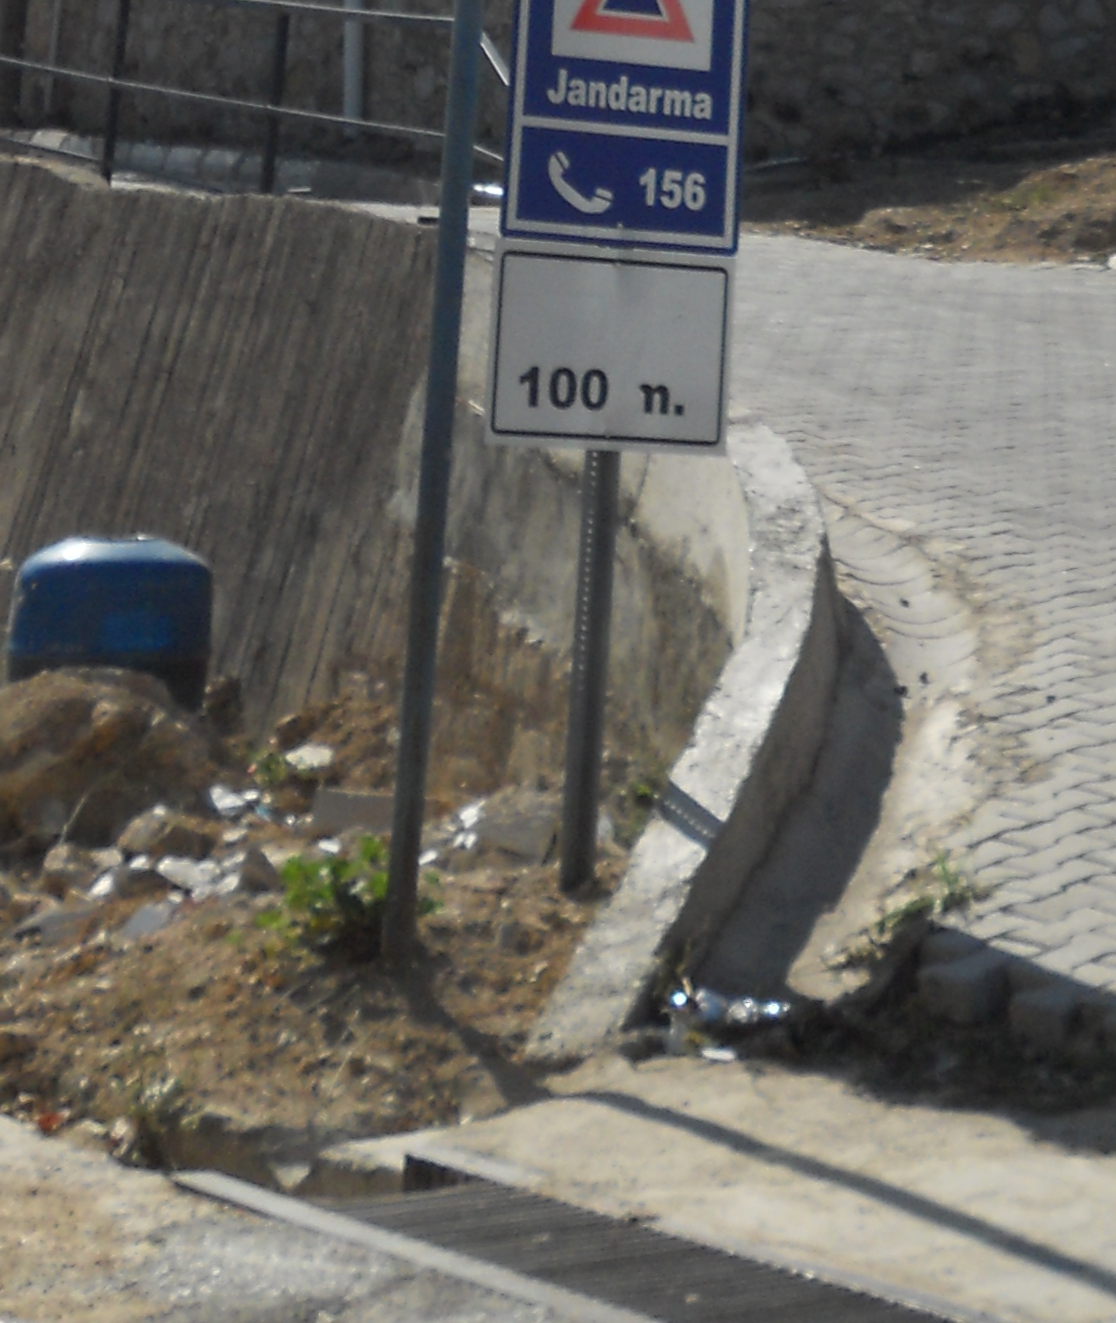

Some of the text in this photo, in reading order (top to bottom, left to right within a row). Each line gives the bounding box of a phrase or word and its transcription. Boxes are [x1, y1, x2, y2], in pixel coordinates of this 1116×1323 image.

[547, 68, 713, 120] Jandarma
[639, 167, 707, 211] 156
[519, 366, 609, 411] 100
